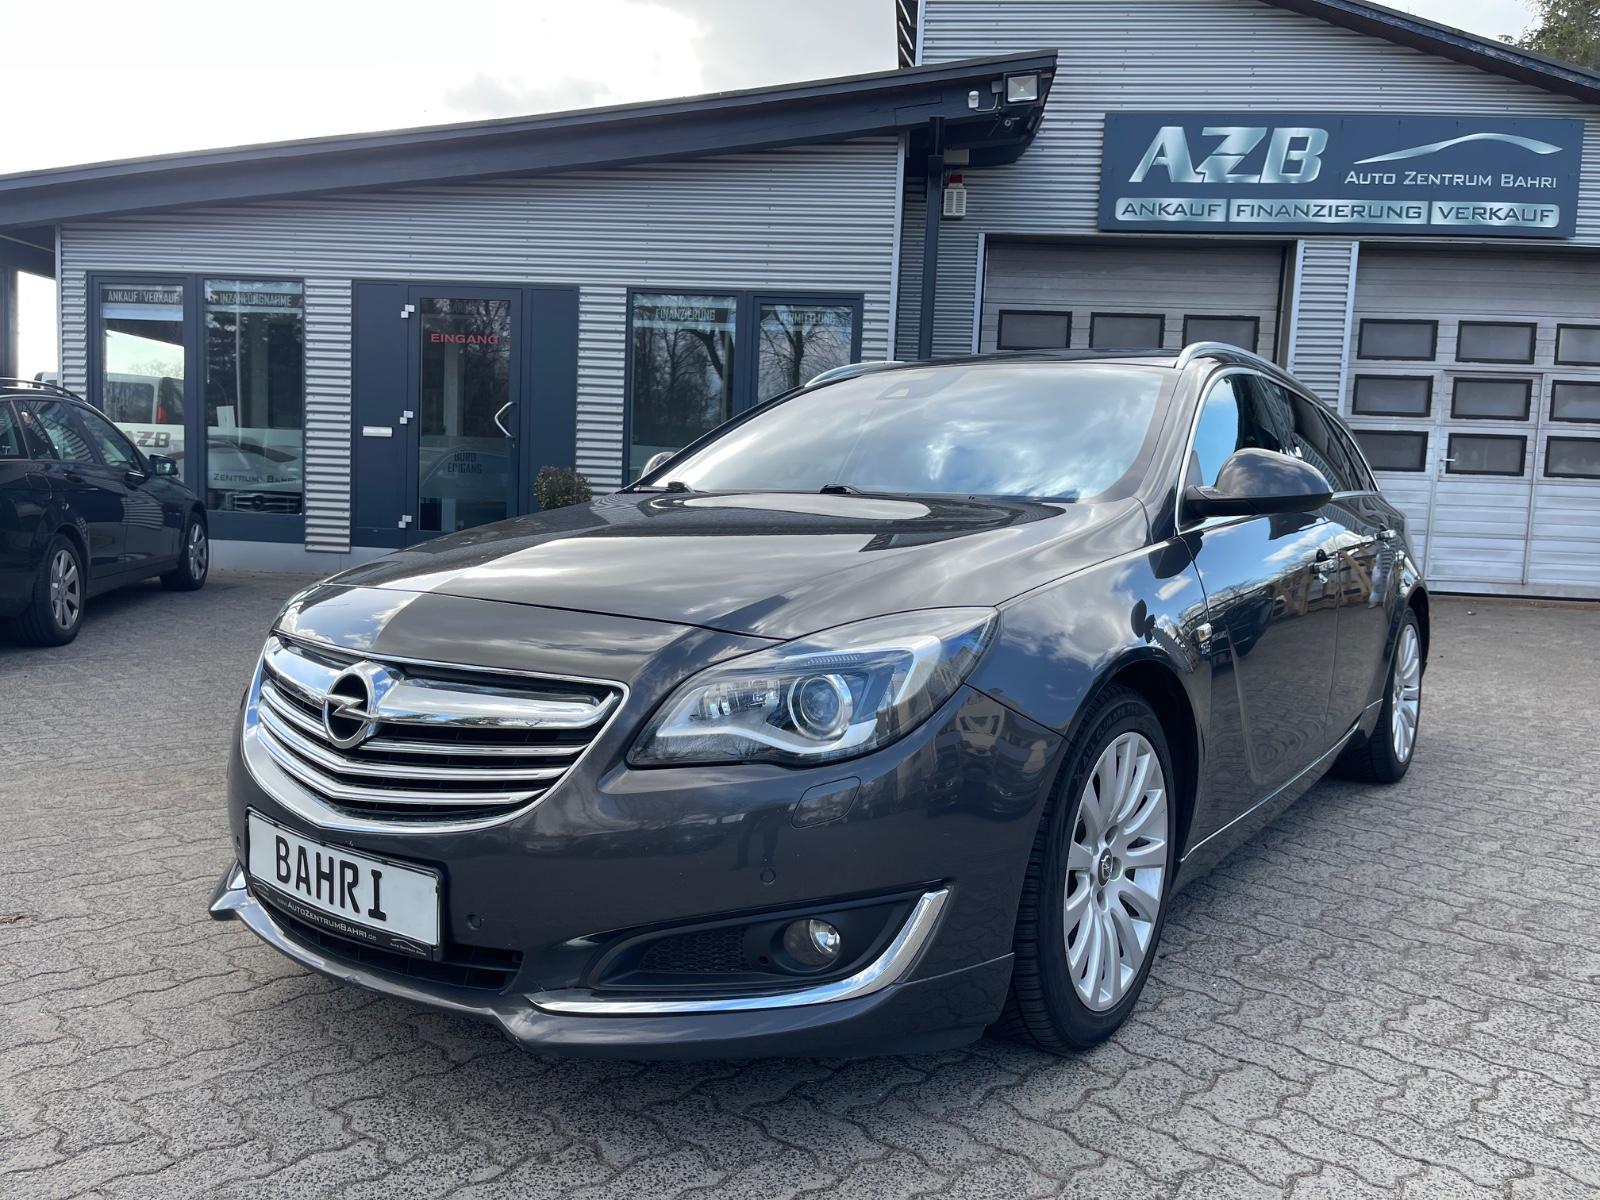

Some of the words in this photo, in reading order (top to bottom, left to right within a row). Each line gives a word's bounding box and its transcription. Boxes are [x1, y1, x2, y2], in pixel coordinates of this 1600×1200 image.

[1128, 126, 1329, 184] AZB
[1344, 170, 1397, 186] AUTO
[1403, 171, 1492, 187] ZENTRUM
[1500, 173, 1557, 188] BAHRI
[1121, 202, 1222, 217] ANKAUF
[1236, 203, 1423, 220] FINANZIERUNG
[1438, 206, 1555, 223] VERKAUF
[107, 290, 139, 302] ANKAUF
[143, 291, 181, 304] VERKAUF
[431, 333, 499, 344] EINGANG
[275, 834, 387, 922] BAHRI
